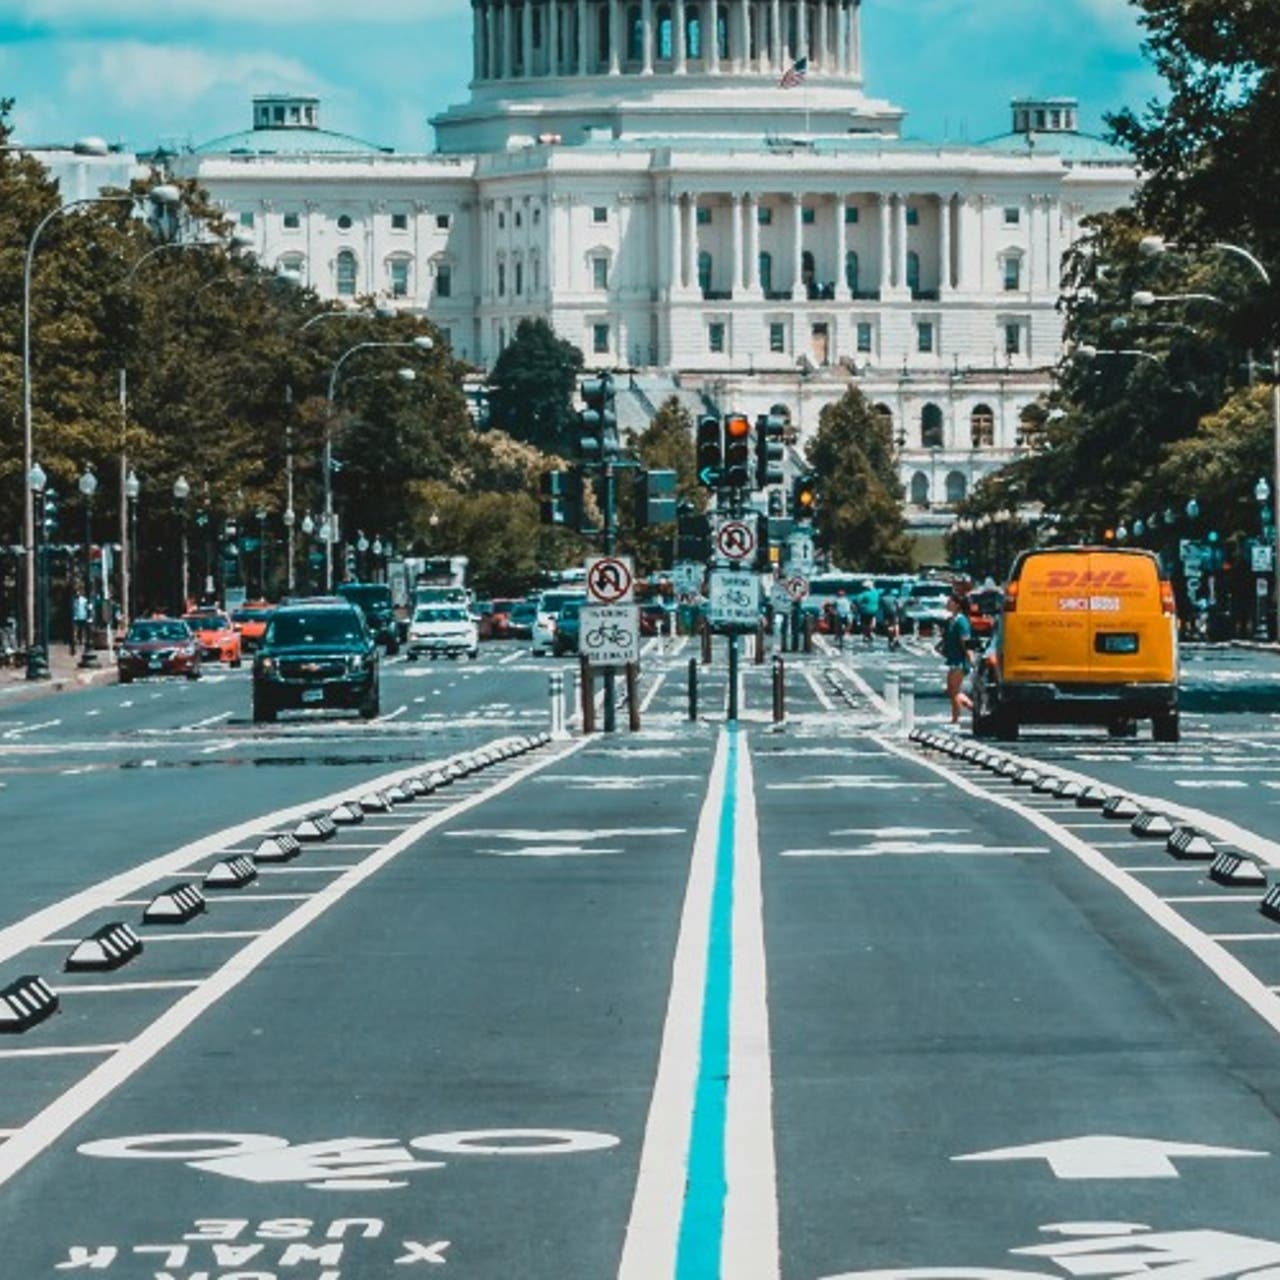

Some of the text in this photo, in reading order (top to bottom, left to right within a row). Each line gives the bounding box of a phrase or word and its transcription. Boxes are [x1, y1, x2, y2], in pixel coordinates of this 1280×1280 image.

[1046, 570, 1131, 589] DHL
[183, 1218, 385, 1240] USE
[55, 1240, 451, 1269] X WALK
